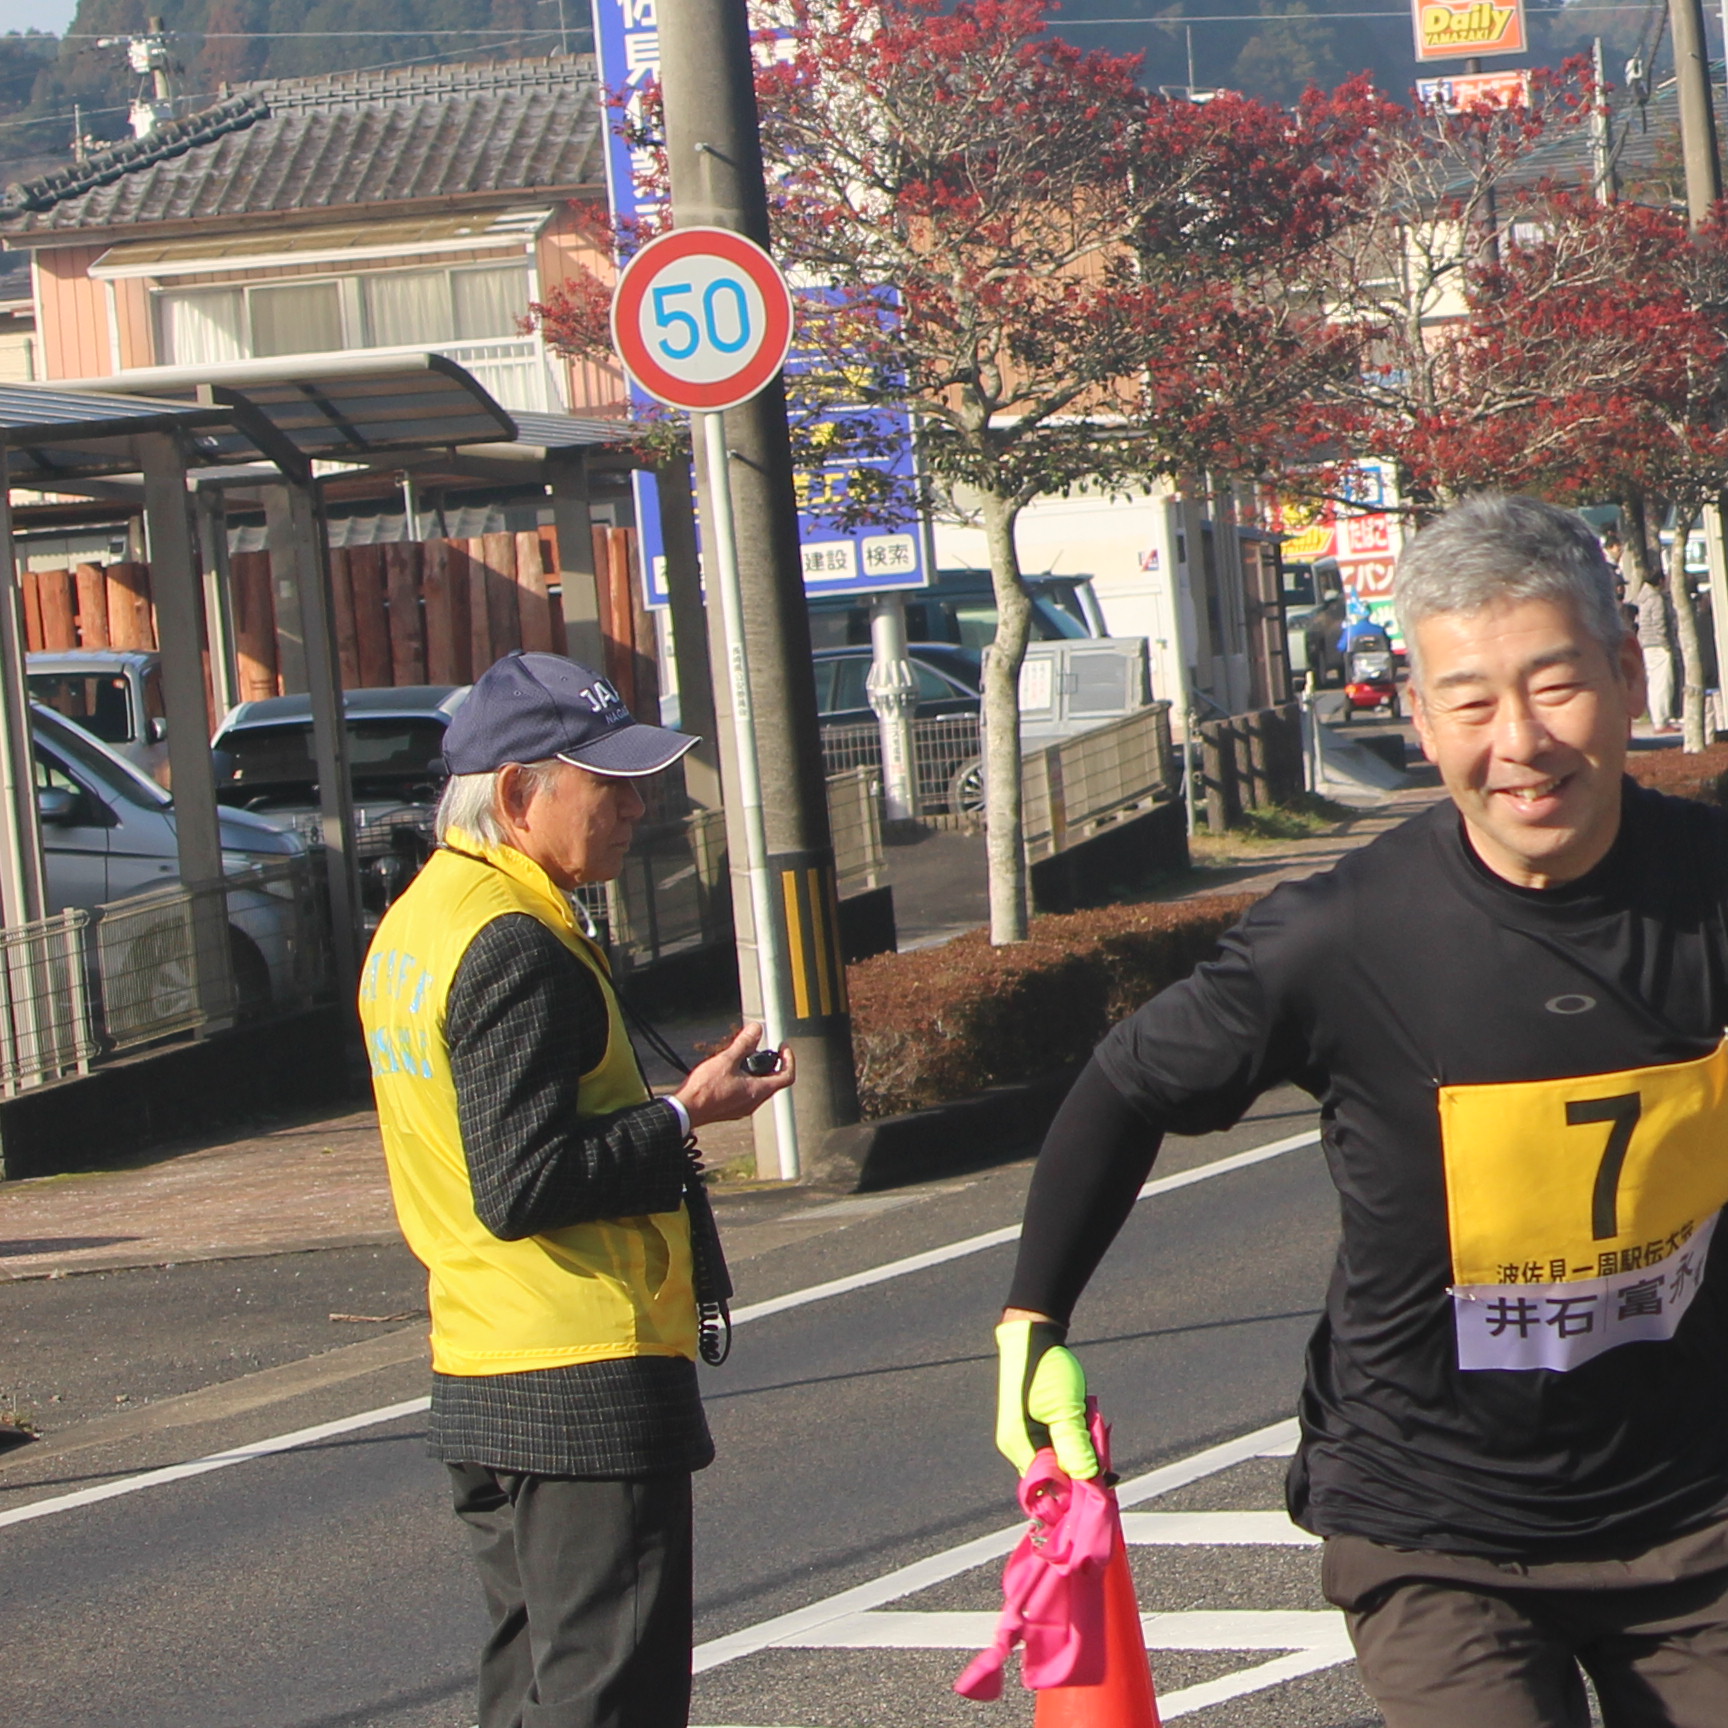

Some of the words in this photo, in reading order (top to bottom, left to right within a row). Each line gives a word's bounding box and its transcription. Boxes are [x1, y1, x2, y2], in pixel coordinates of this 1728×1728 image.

[1424, 2, 1514, 40] Daily
[1425, 28, 1490, 46] YAMAZAKI
[652, 278, 751, 360] 50
[1351, 519, 1388, 549] たばこ
[867, 544, 910, 568] 検索
[1564, 1091, 1641, 1241] 7
[1485, 1294, 1598, 1339] 井石
